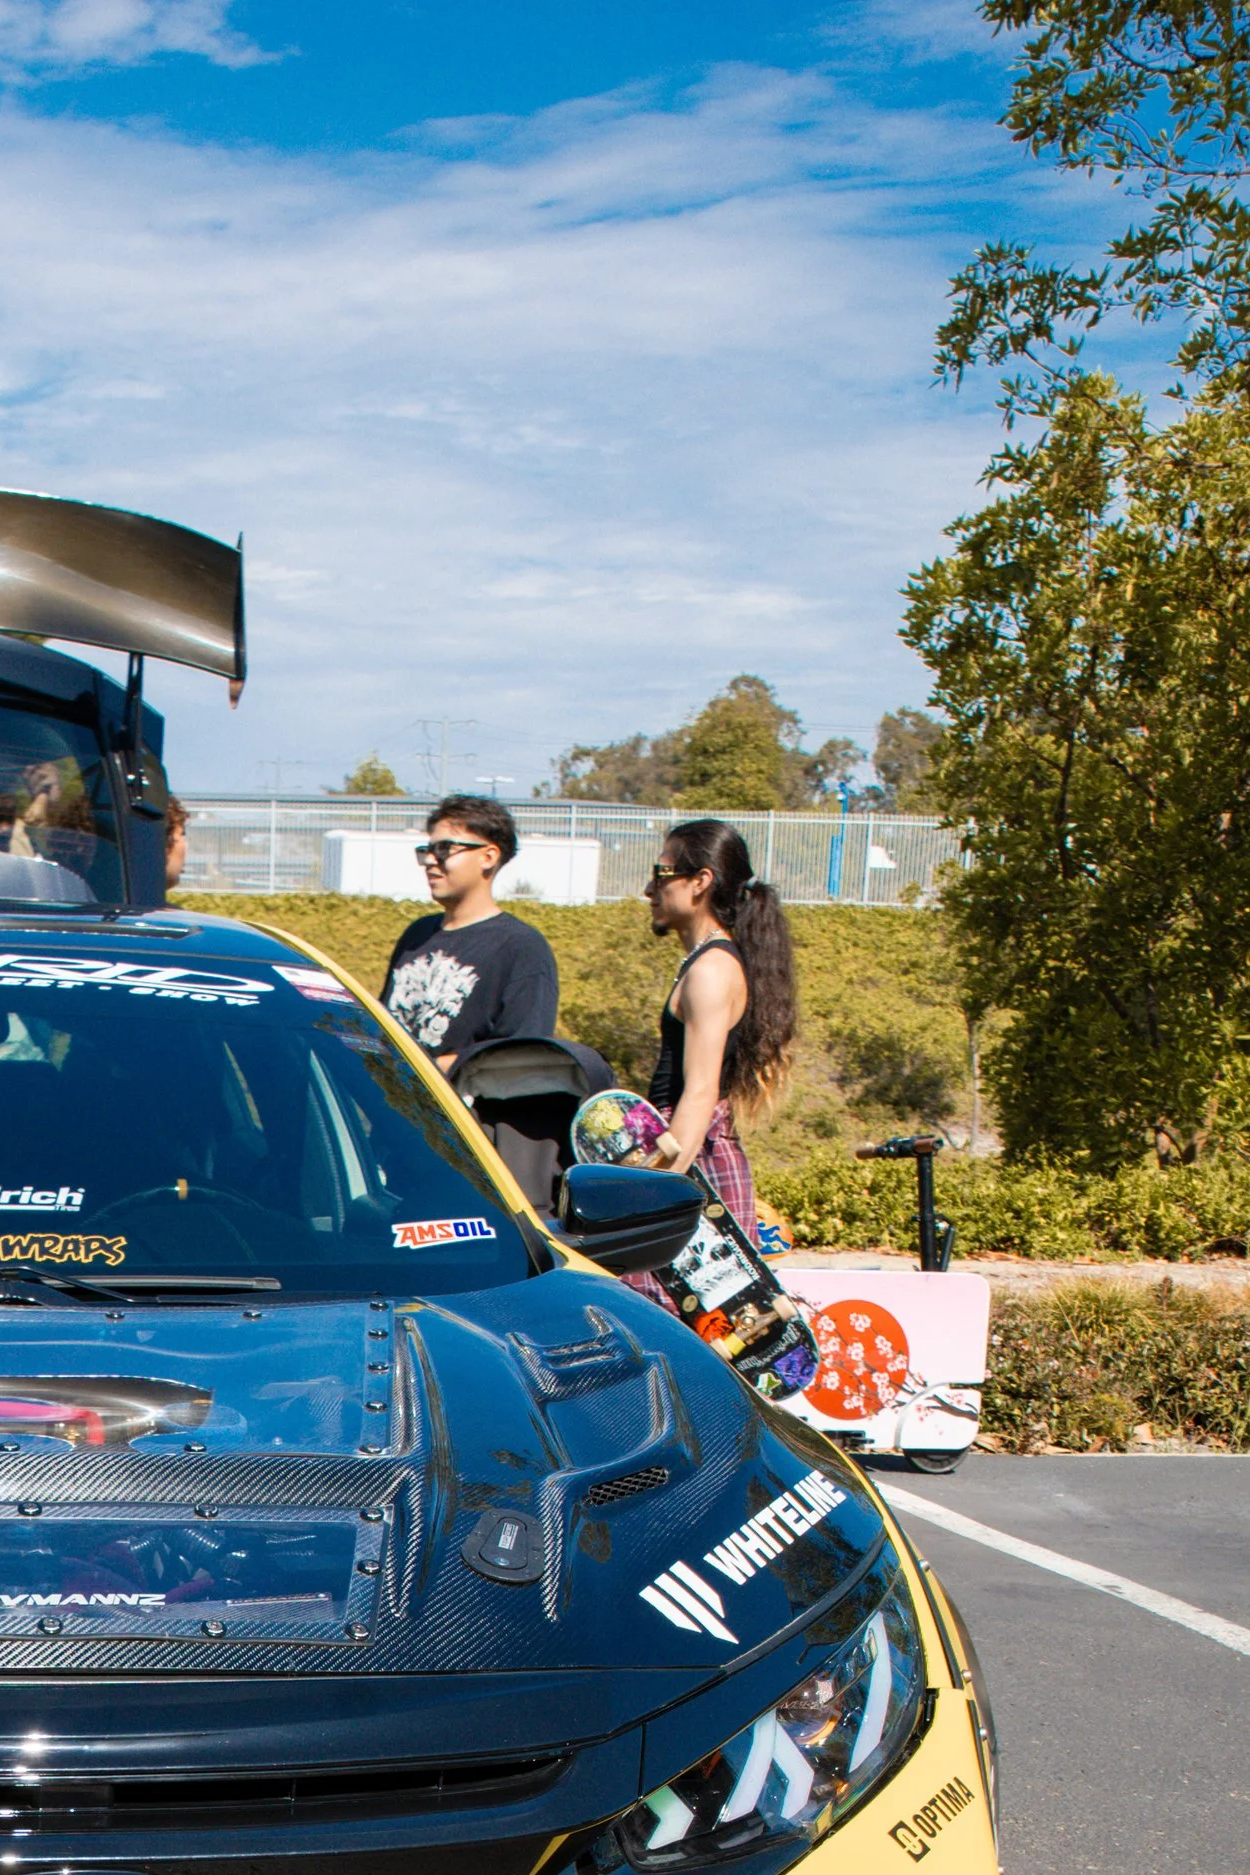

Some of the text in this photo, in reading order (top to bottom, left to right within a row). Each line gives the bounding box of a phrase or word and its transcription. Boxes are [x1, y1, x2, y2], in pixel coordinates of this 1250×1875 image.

[128, 986, 261, 1007] SHOW
[395, 1220, 493, 1247] AMSOIL
[703, 1470, 847, 1585] WHITELINE
[911, 1776, 976, 1839] OPTIMA
